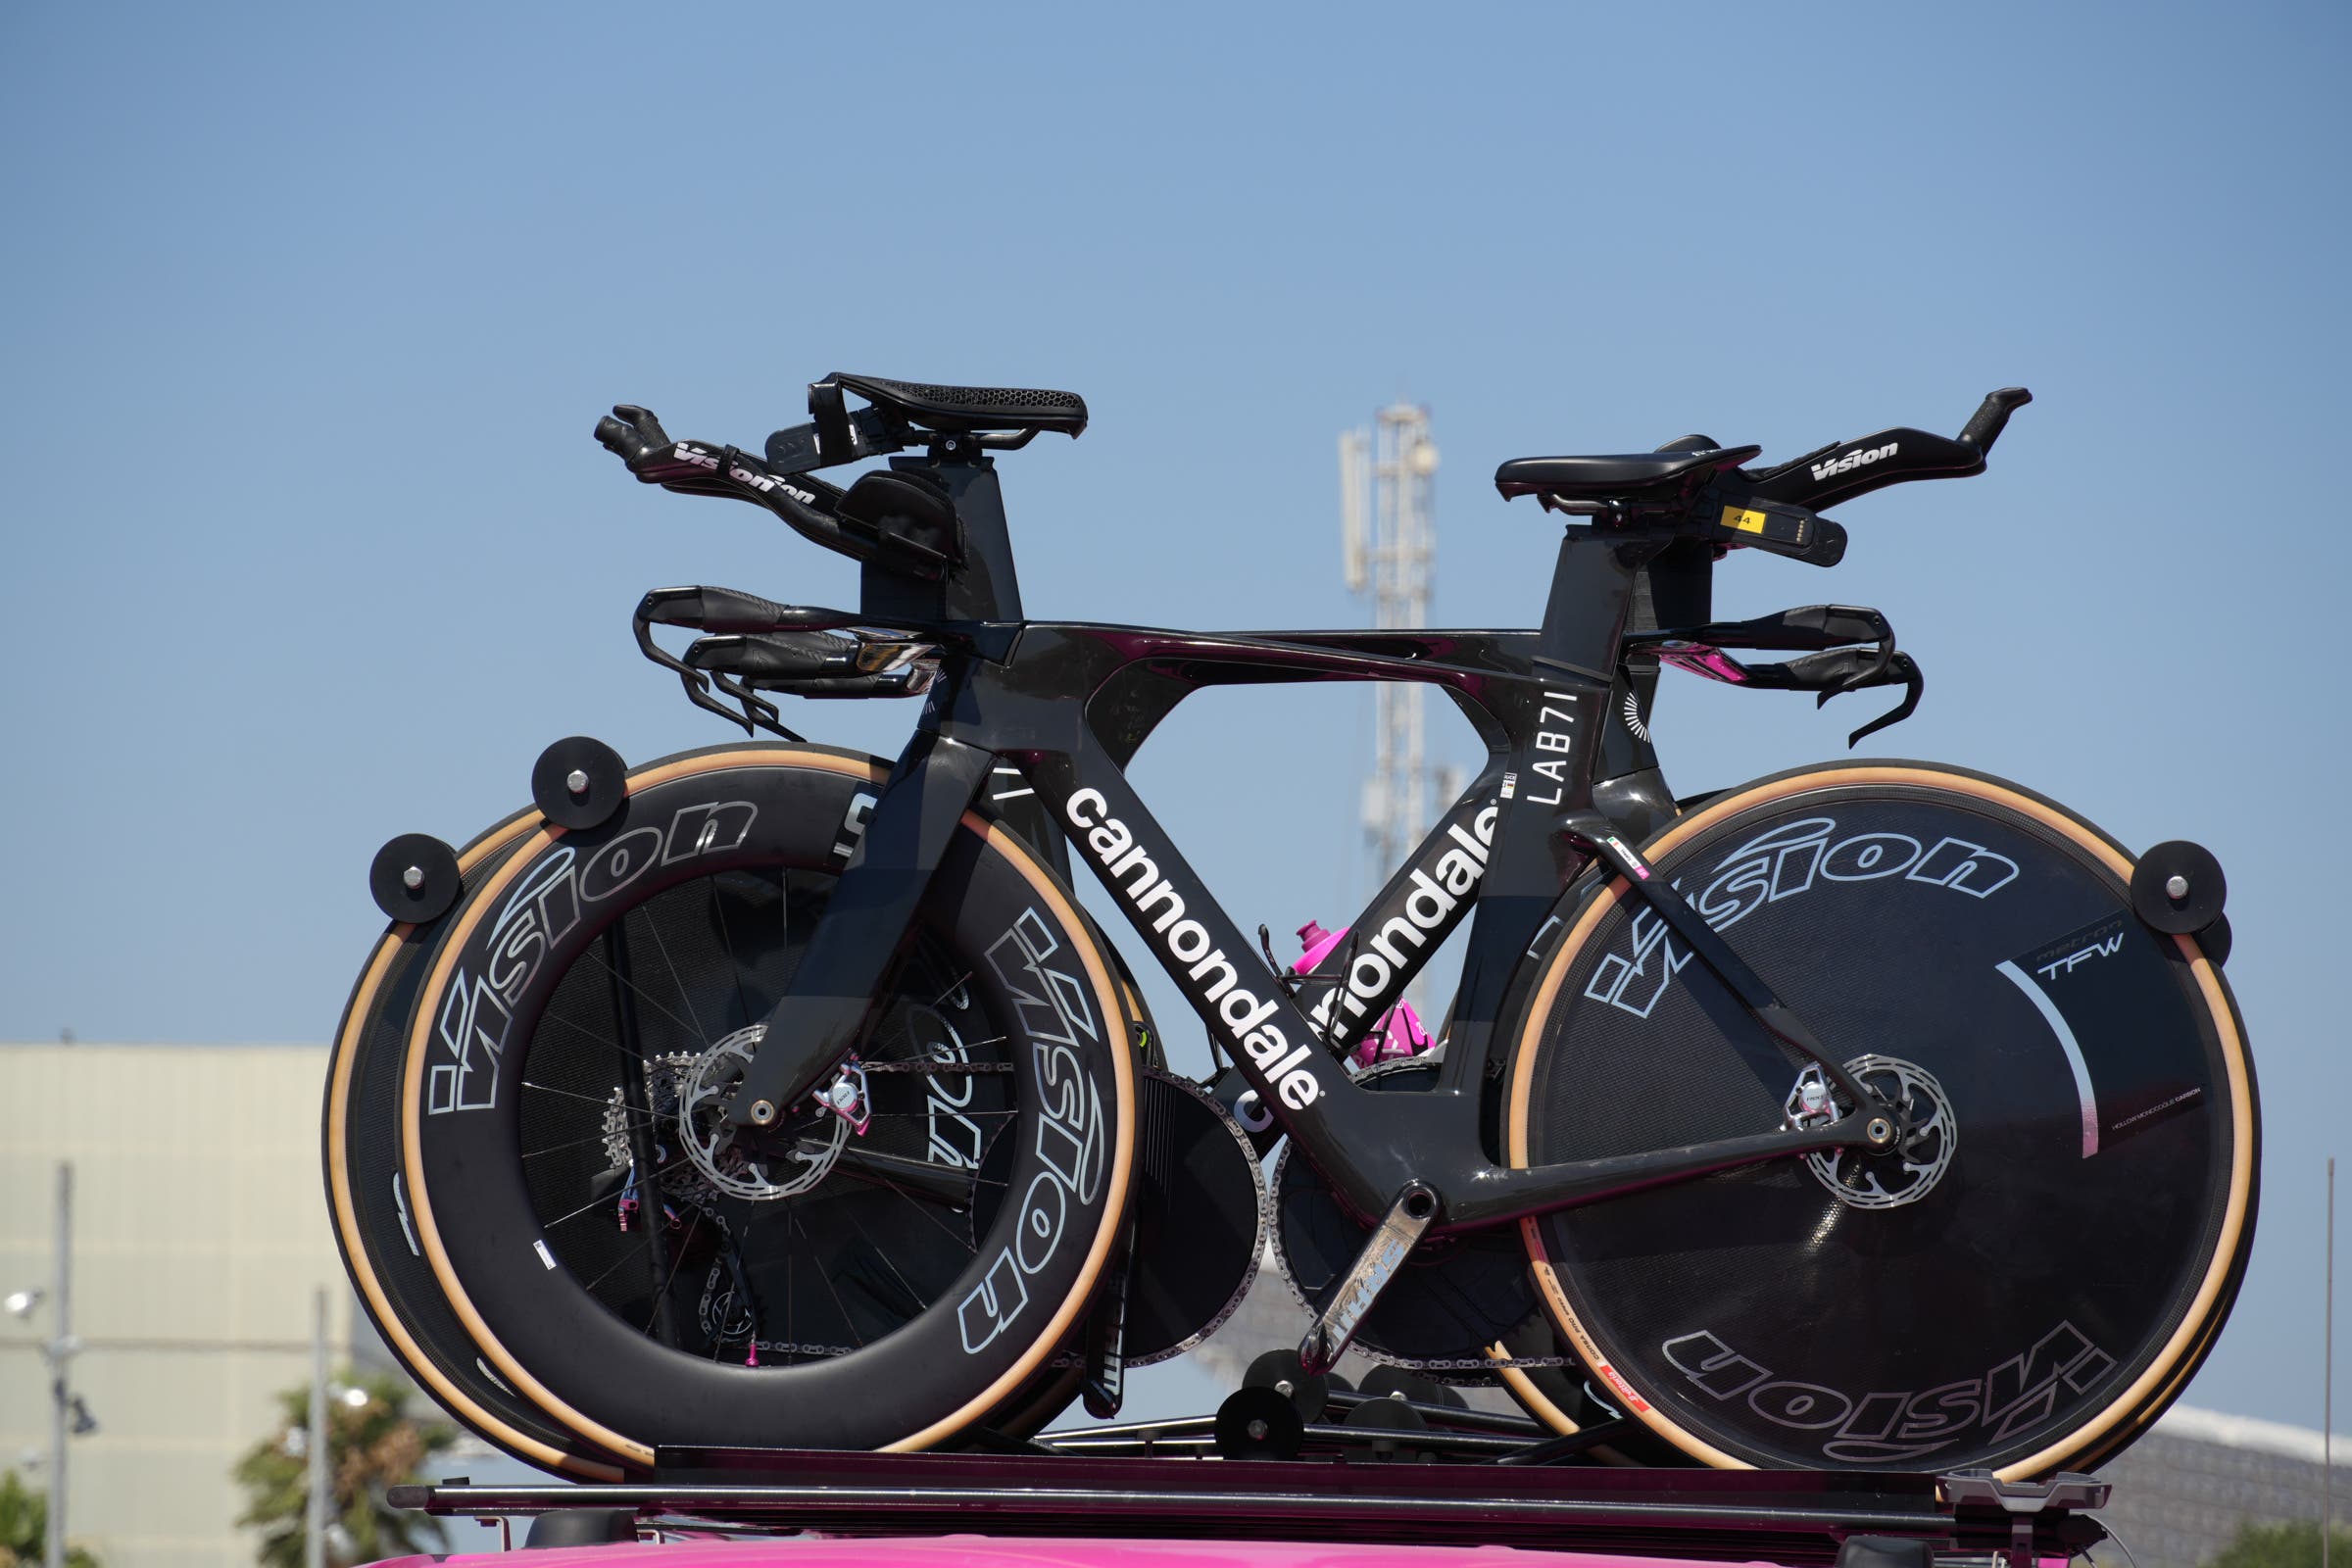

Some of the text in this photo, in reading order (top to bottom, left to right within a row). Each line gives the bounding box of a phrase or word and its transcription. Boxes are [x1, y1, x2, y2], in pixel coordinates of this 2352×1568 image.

[673, 442, 775, 492] Vison
[1811, 442, 1898, 481] Vision
[1733, 514, 1751, 525] 44
[1527, 691, 1578, 805] LAB71
[428, 801, 759, 1115] Vision
[1066, 788, 1319, 1110] cannondale
[2037, 932, 2125, 981] TFW
[957, 906, 1105, 1354] Vision
[1579, 1335, 1599, 1361] CORSA
[1662, 1319, 2118, 1463] Vision
